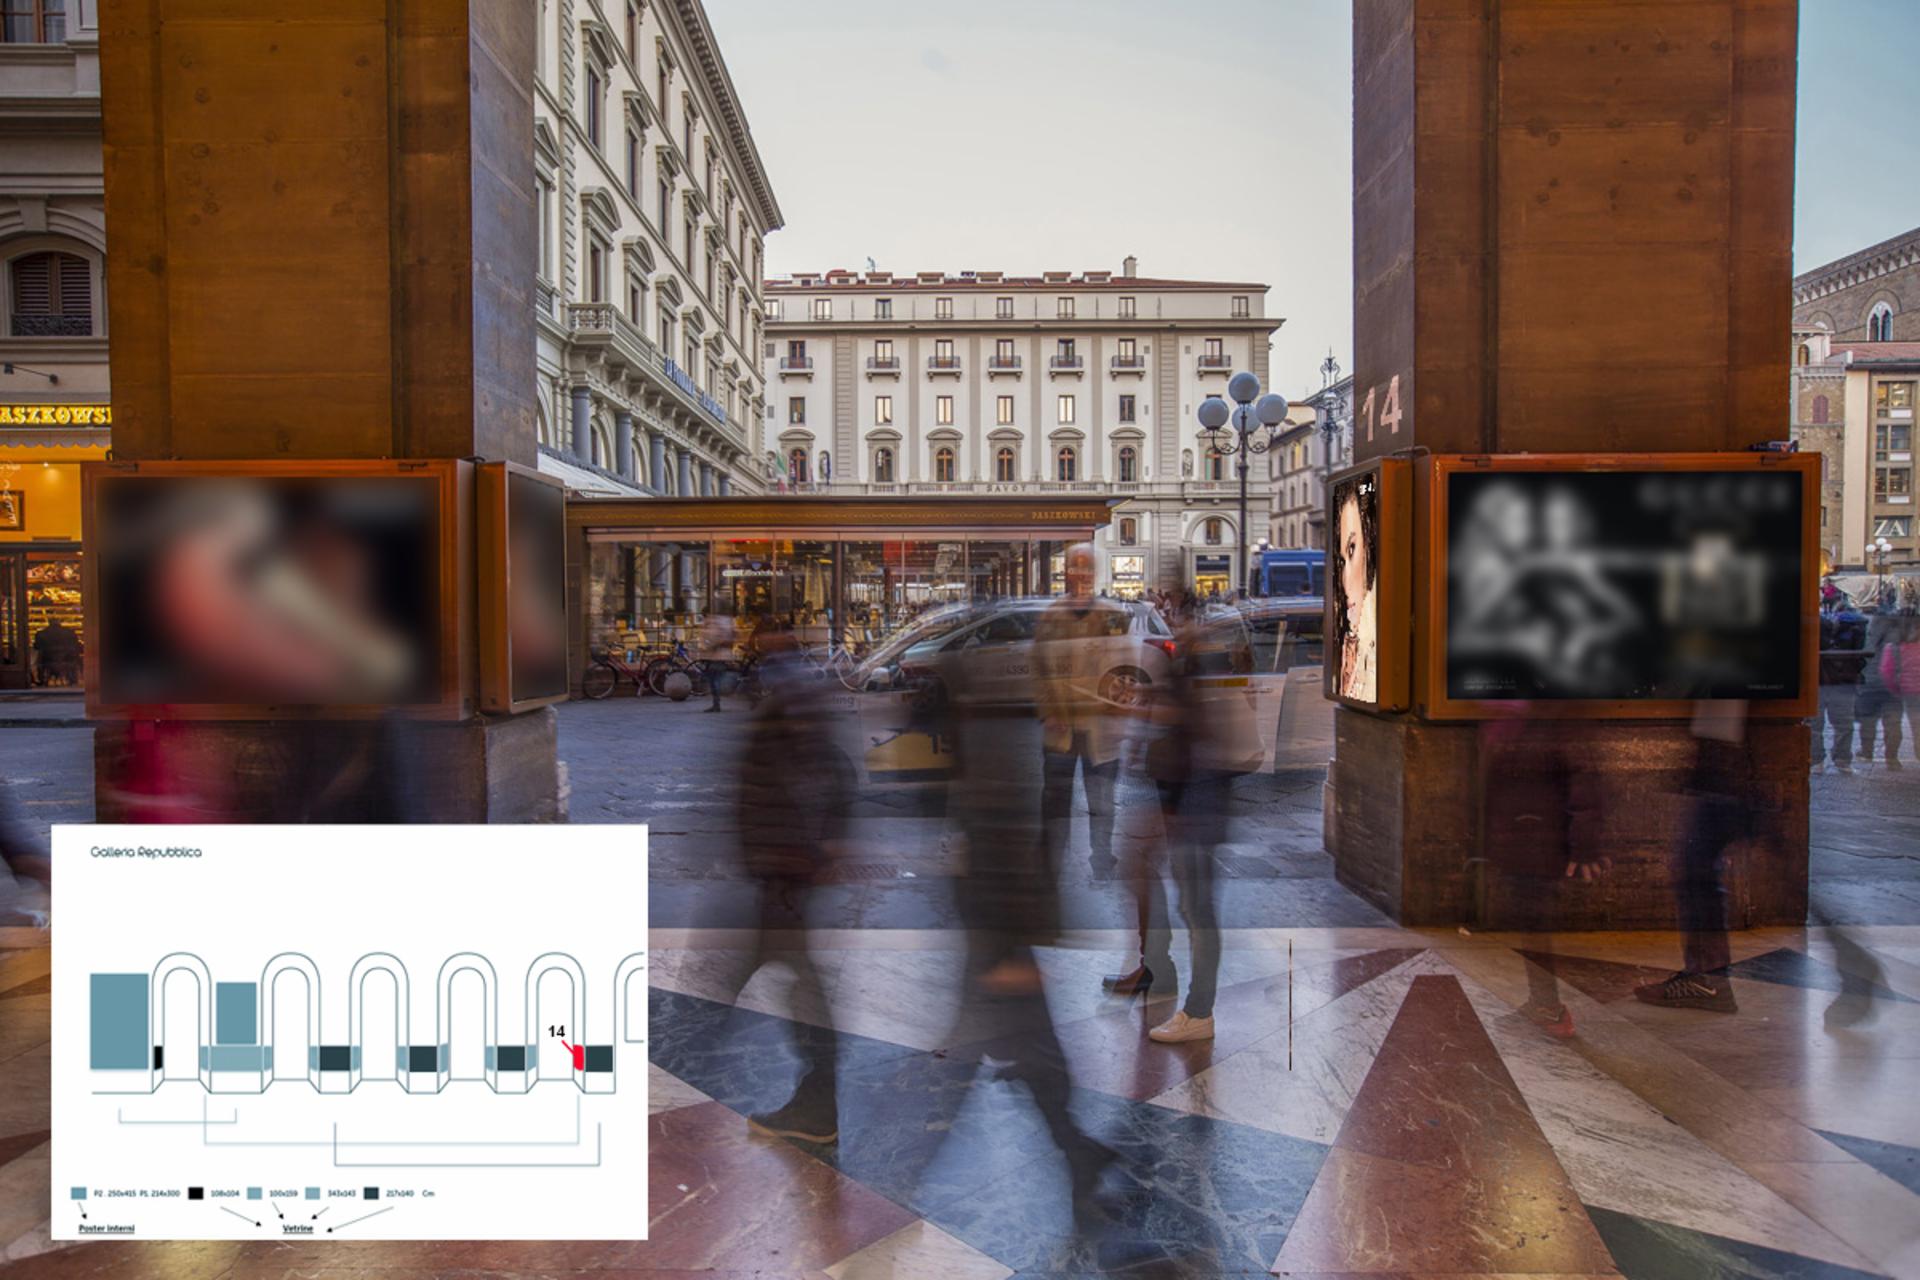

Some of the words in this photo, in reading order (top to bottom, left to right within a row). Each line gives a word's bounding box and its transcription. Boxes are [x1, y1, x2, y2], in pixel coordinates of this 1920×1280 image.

[1362, 374, 1402, 442] 14
[986, 484, 1027, 492] SAVOY
[1874, 519, 1920, 537] ZA
